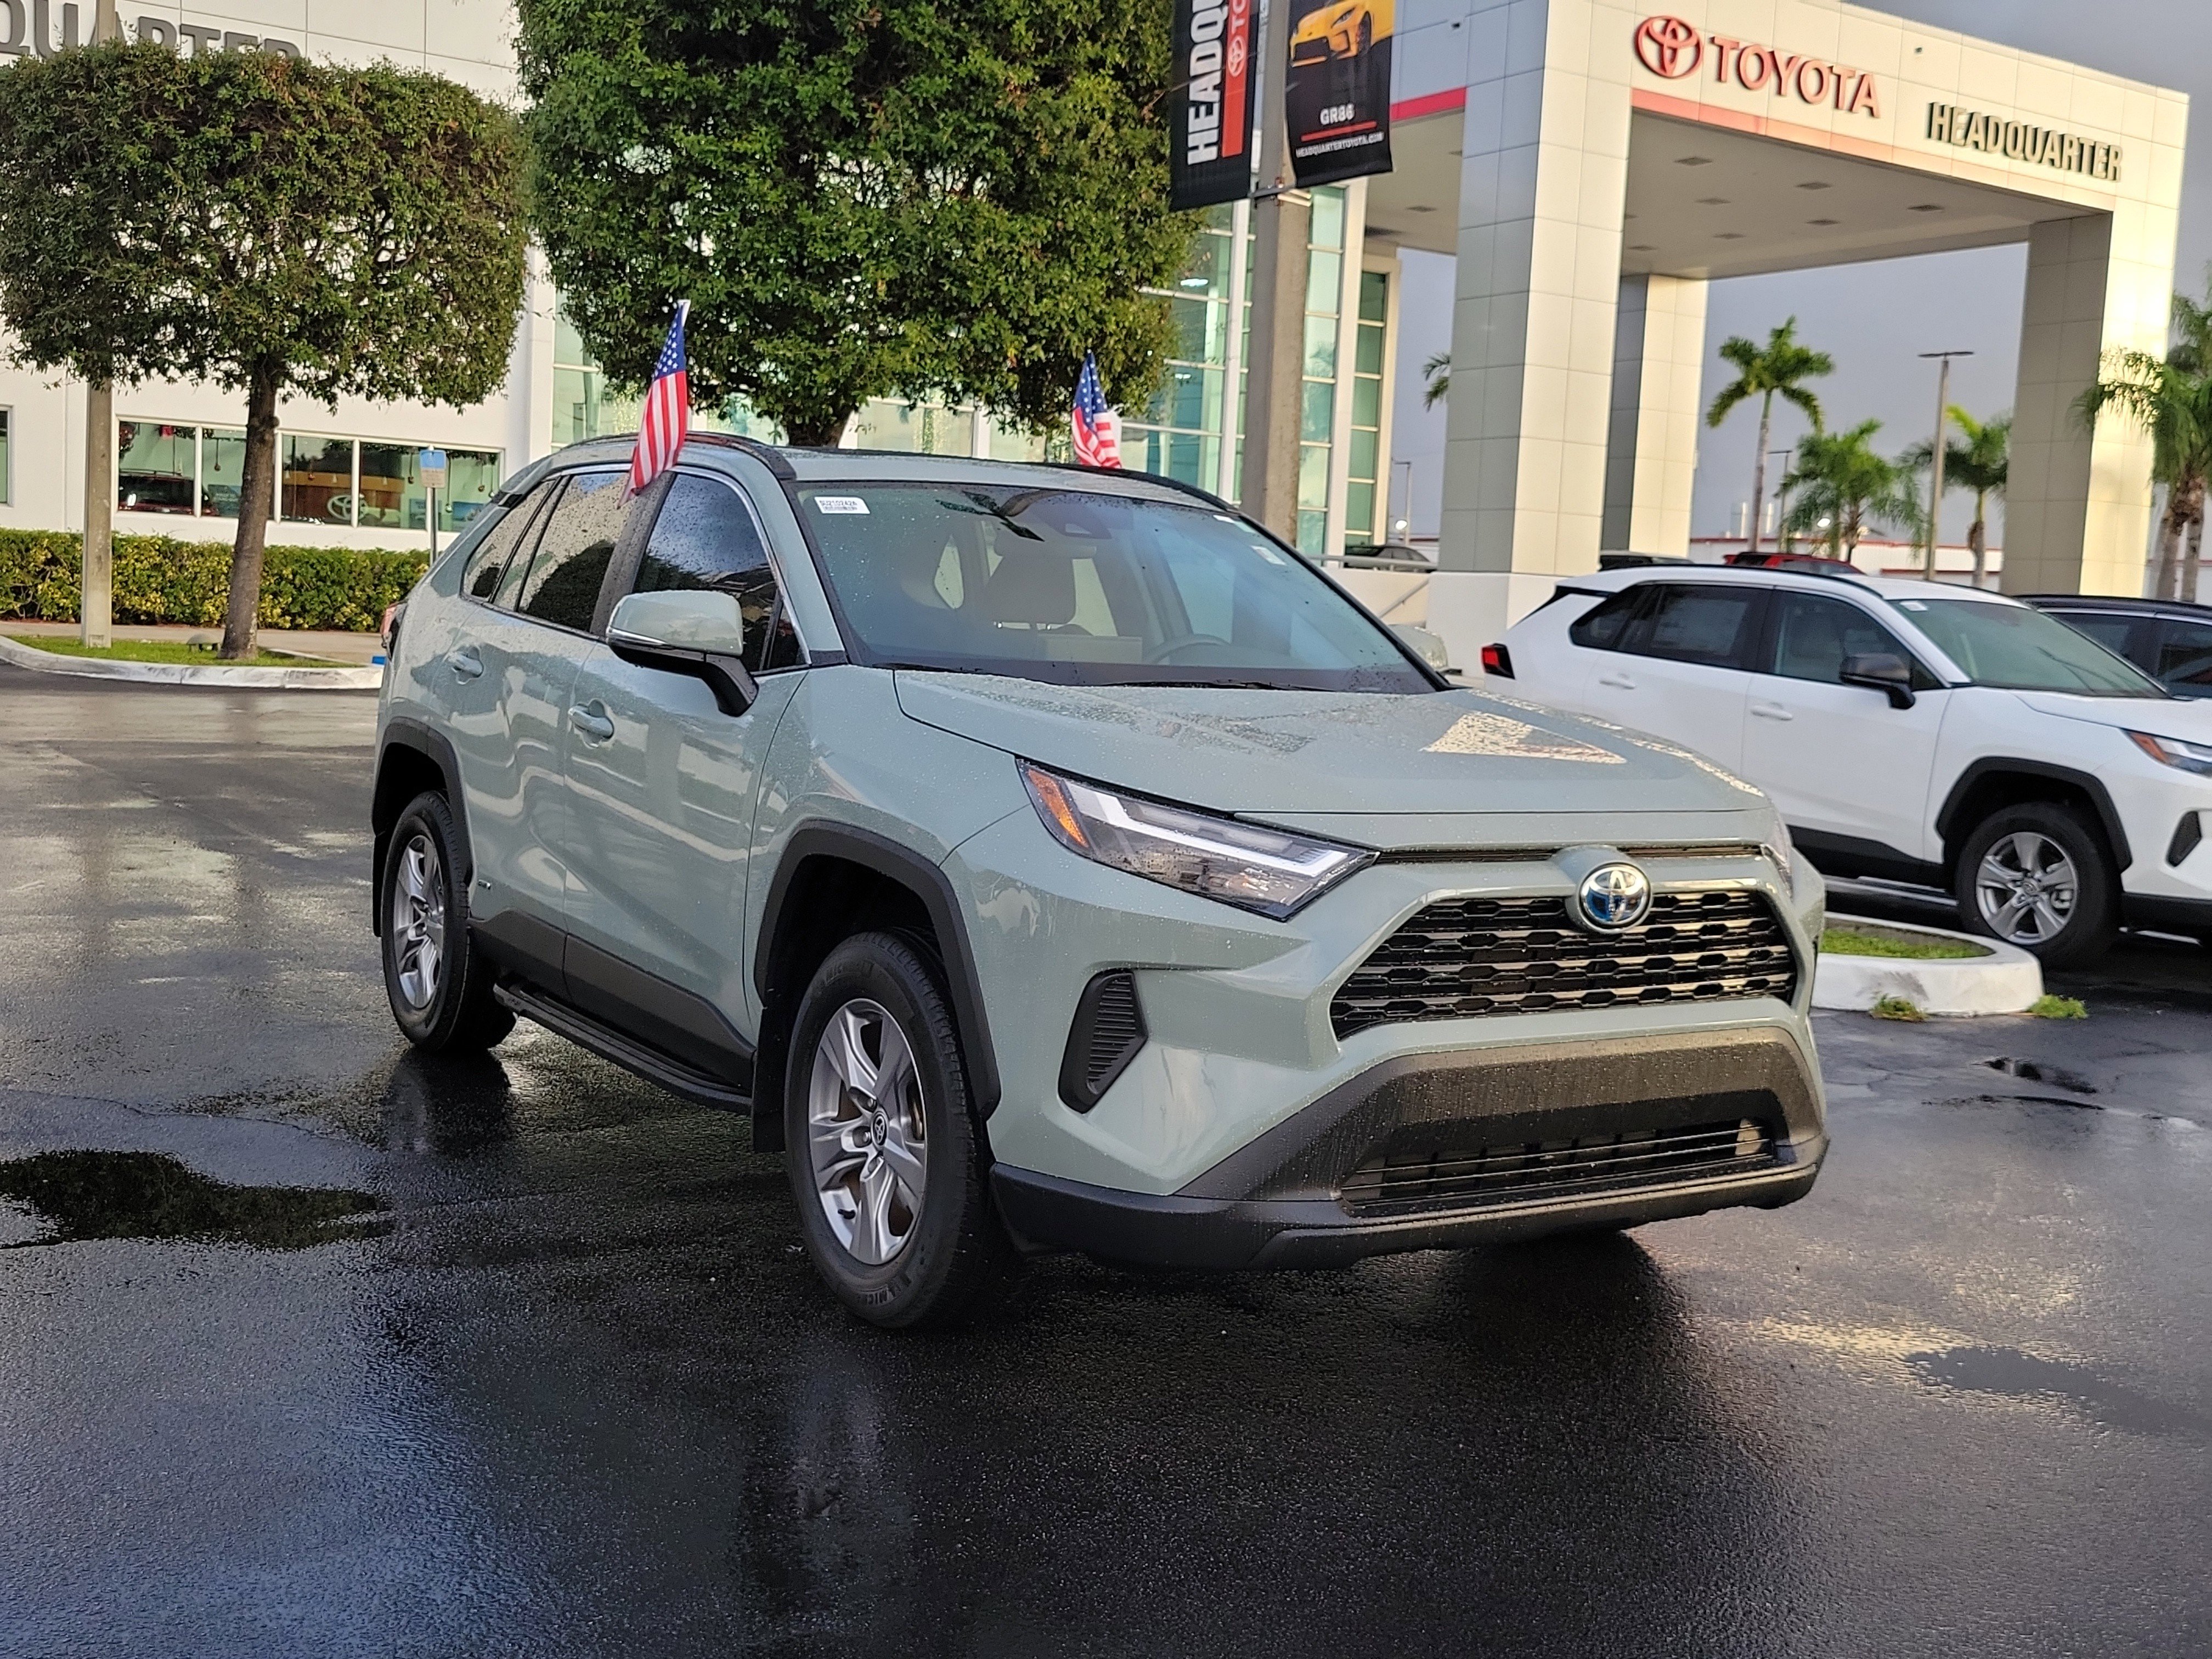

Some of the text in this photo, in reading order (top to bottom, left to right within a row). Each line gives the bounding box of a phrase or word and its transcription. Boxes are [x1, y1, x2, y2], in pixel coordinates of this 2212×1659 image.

[1320, 103, 1355, 125] GR86
[1709, 36, 2123, 182] TOYOTA HEADQUARTER
